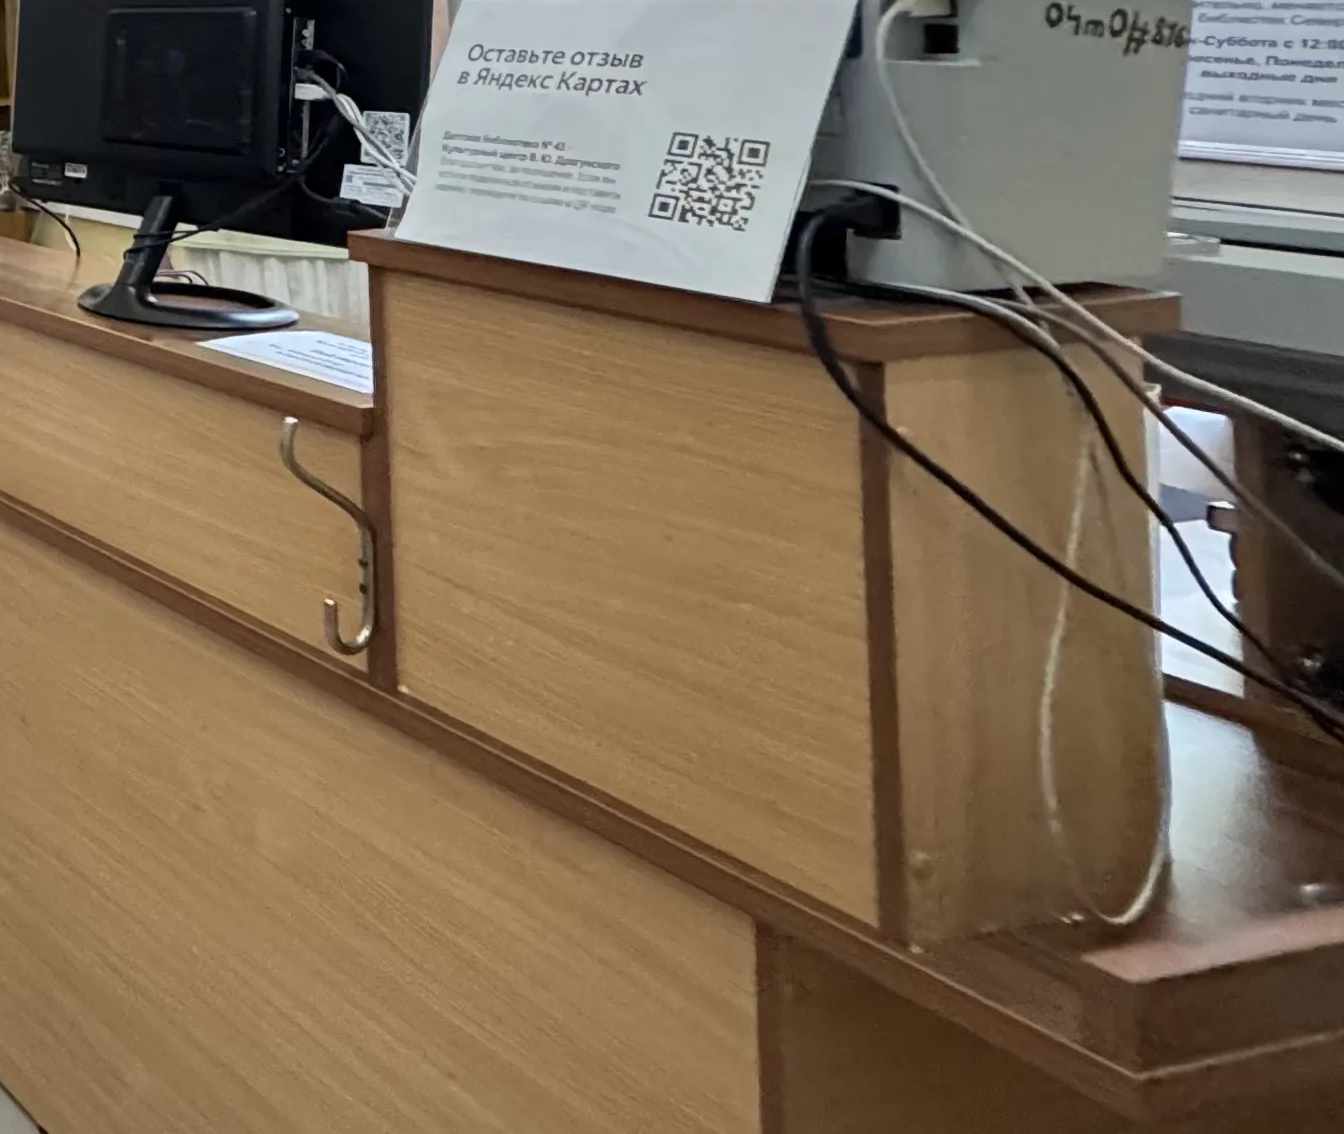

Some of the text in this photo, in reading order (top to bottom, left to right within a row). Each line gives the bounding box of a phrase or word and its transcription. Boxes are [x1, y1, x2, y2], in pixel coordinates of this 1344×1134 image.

[467, 43, 644, 69] Оставьте отзыв
[1283, 39, 1294, 49] с
[457, 68, 647, 97] в Яндекс Картах
